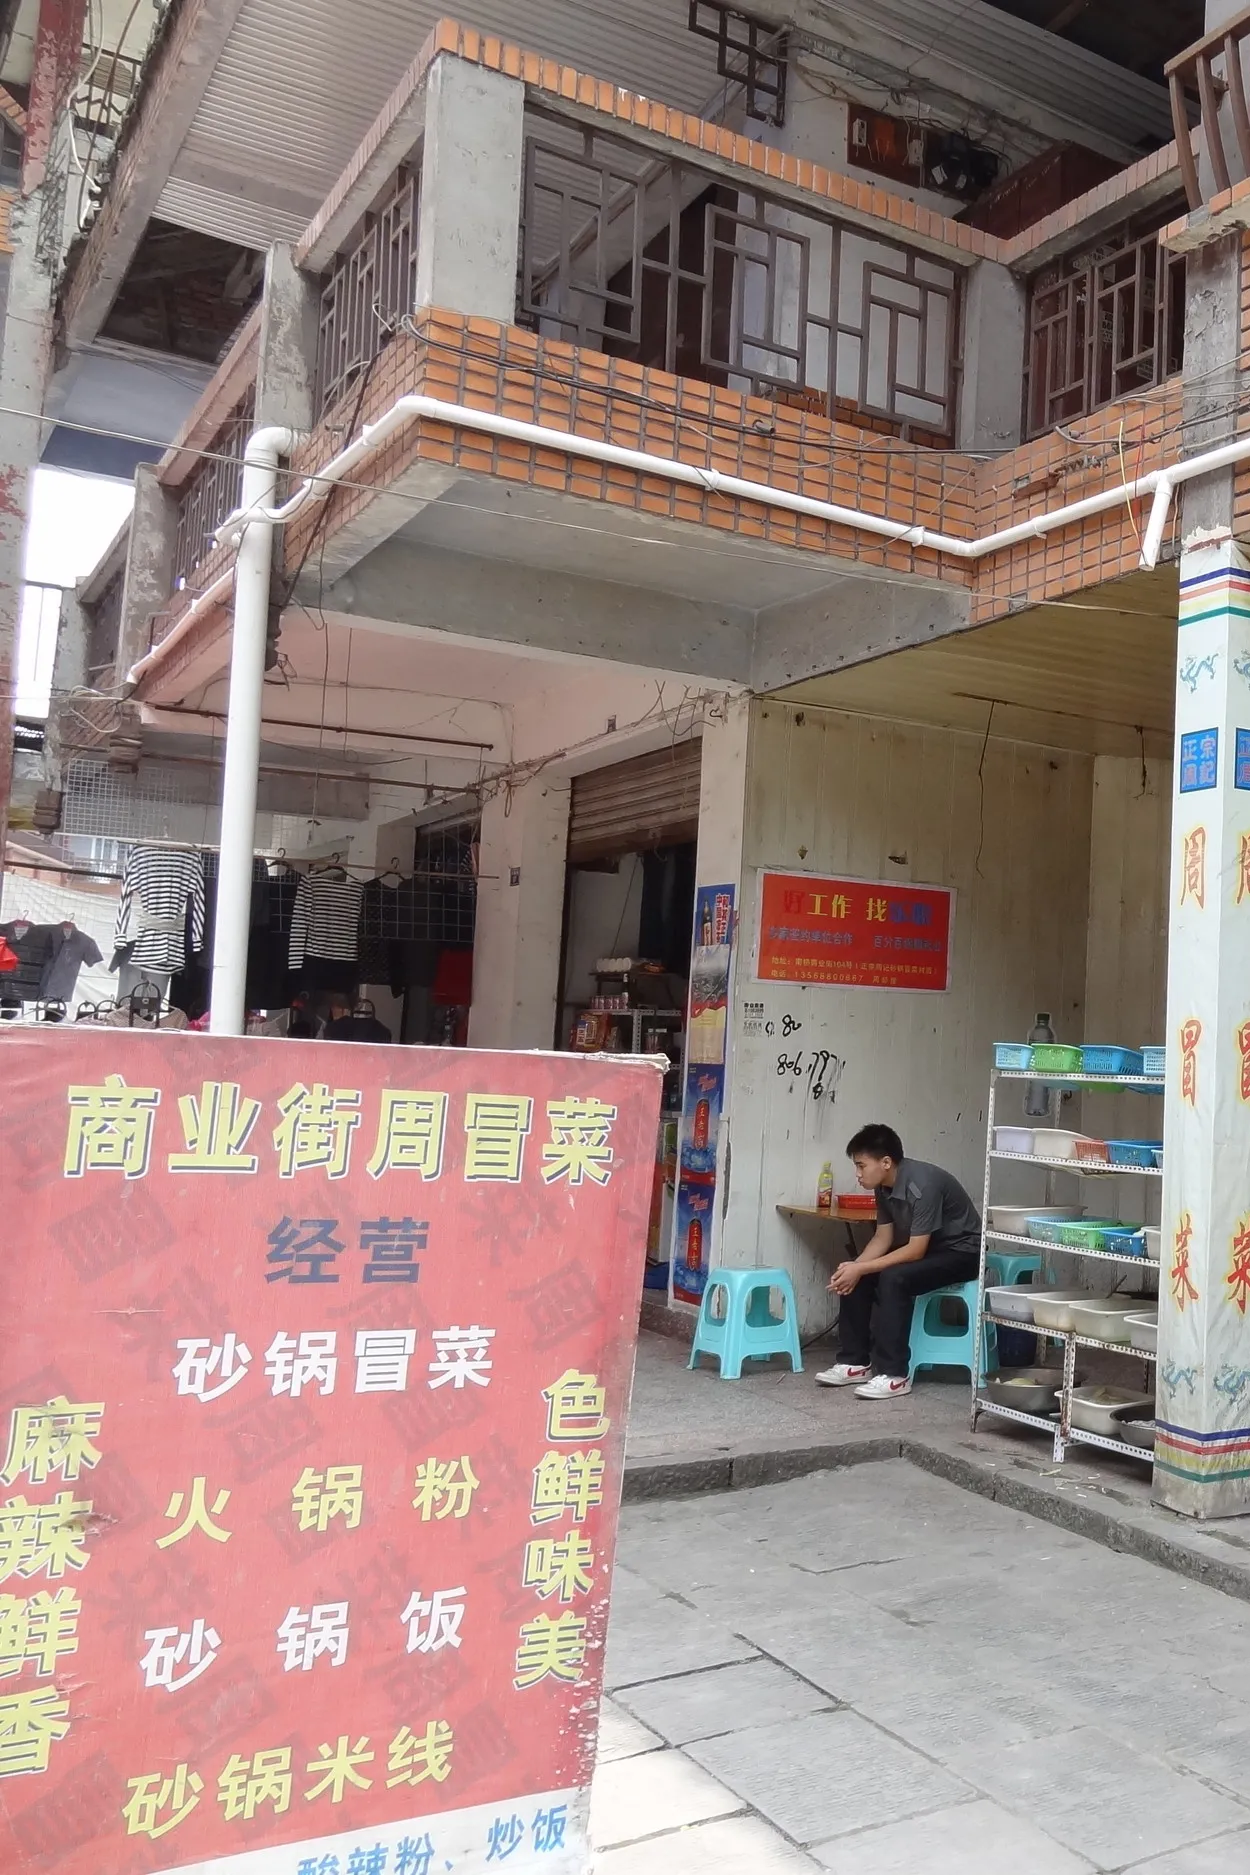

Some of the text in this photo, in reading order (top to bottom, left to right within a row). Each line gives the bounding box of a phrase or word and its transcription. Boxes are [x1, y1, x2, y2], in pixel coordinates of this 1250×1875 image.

[63, 1074, 617, 1186] 商业街周冒菜
[264, 1215, 430, 1286] 经营
[172, 1325, 496, 1403] 砂锅冒菜
[156, 1456, 480, 1549] 火锅粉
[512, 1368, 610, 1691] 色鲜味美
[0, 1395, 105, 1776] 麻辣鲜香
[139, 1584, 467, 1692] 砂锅饭
[121, 1720, 455, 1839] 砂锅米线
